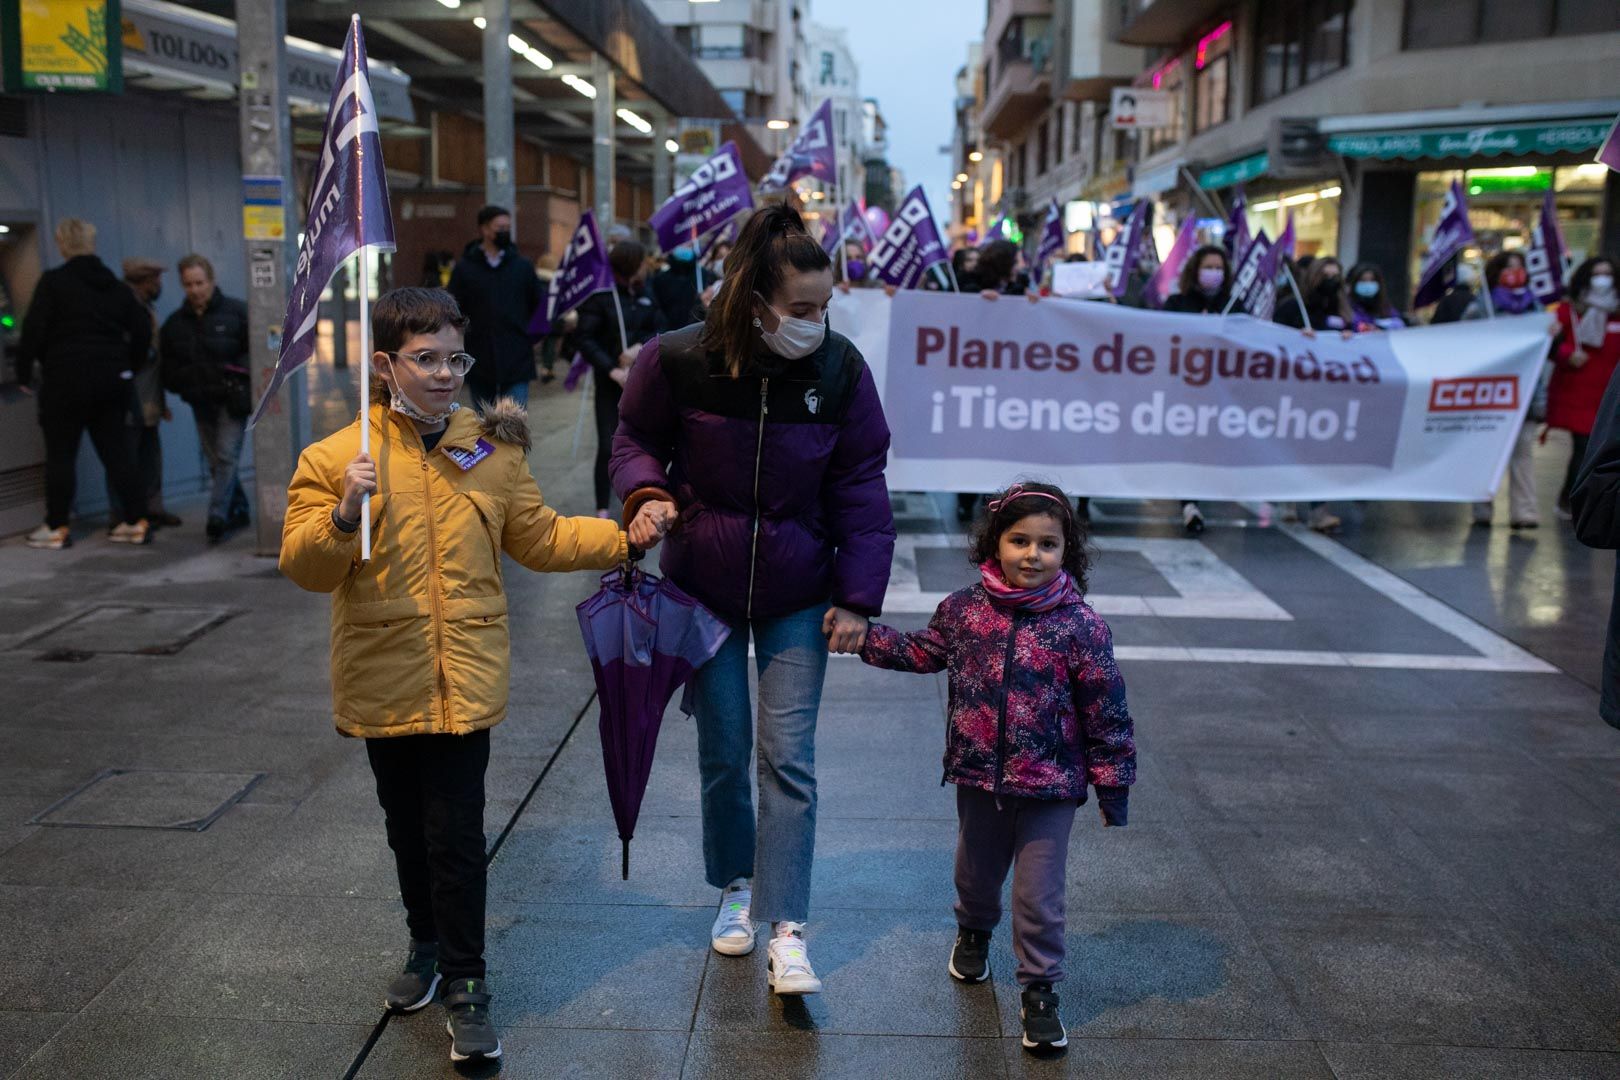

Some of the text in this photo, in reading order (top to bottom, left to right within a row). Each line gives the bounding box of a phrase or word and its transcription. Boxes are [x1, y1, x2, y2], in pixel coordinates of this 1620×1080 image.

[916, 326, 1380, 388] Planes de igualdad
[931, 384, 1361, 442] ¡Tienes derecho!
[1435, 381, 1514, 407] CCOO
